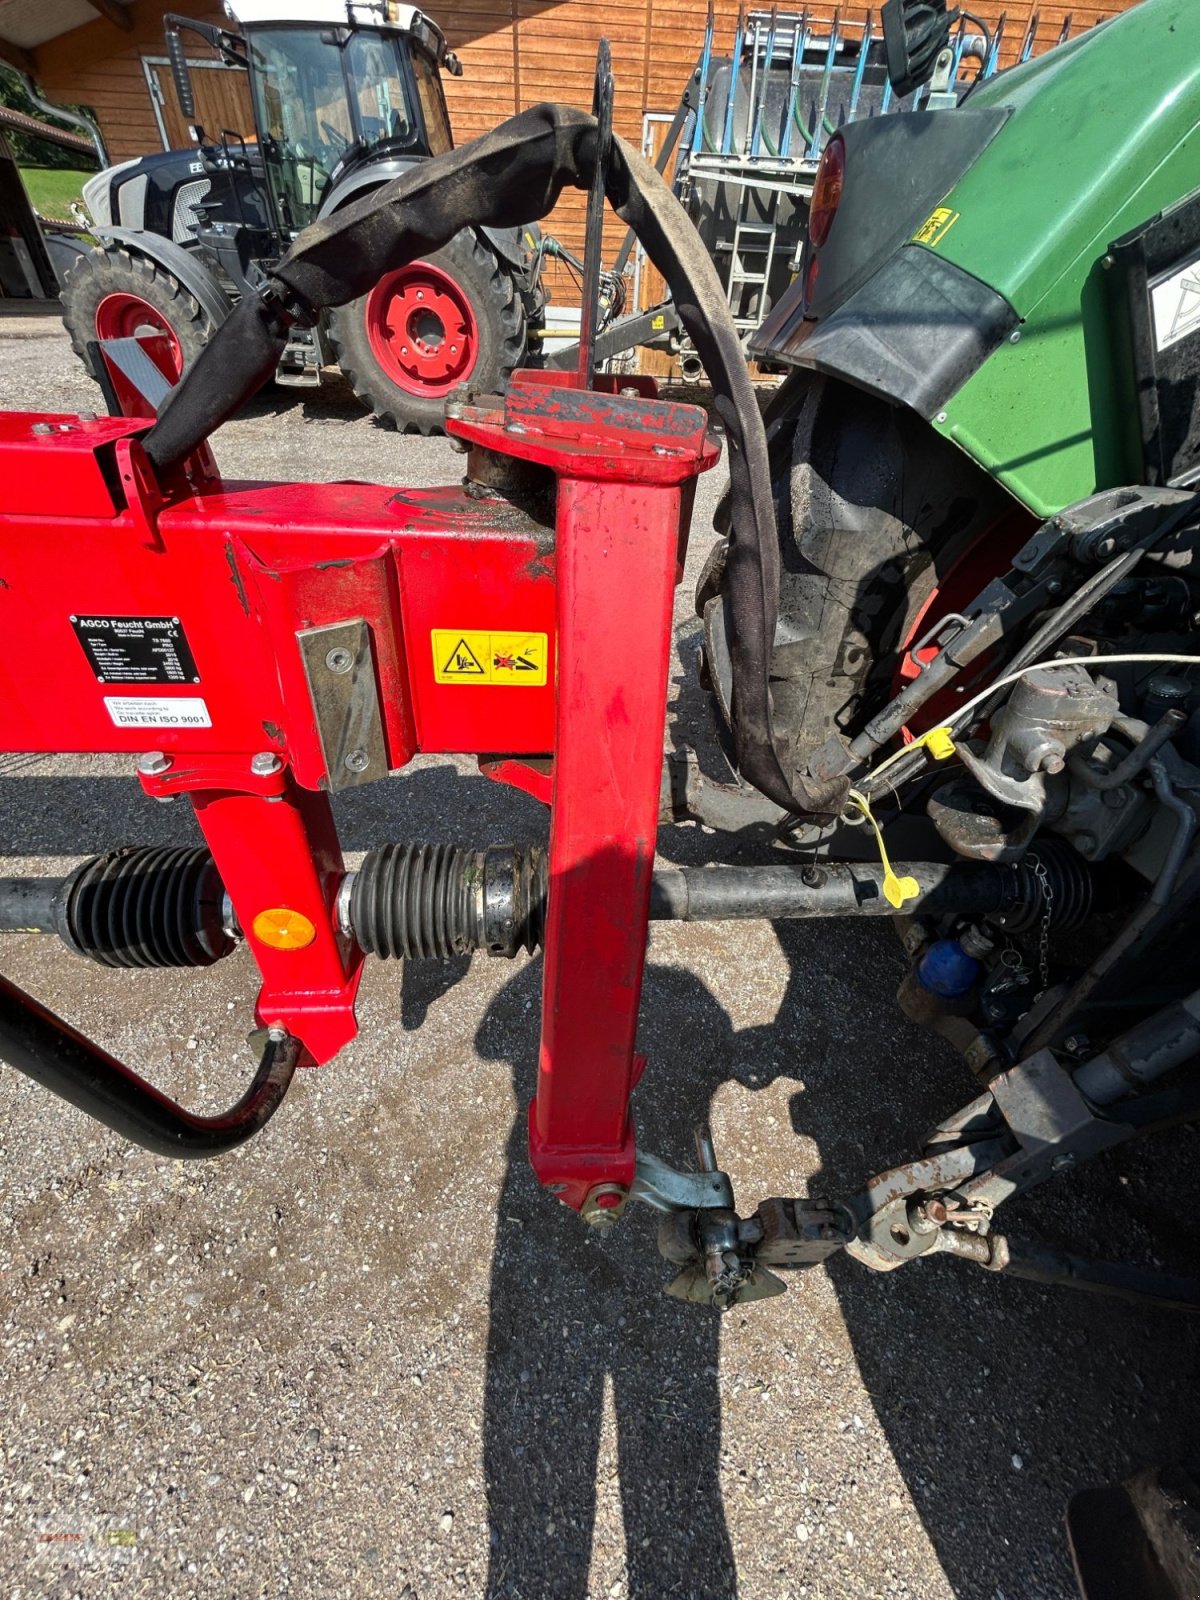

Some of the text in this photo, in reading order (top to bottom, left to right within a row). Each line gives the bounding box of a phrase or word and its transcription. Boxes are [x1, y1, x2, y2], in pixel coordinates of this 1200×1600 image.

[80, 620, 174, 629] AGCO Feucht GmbH
